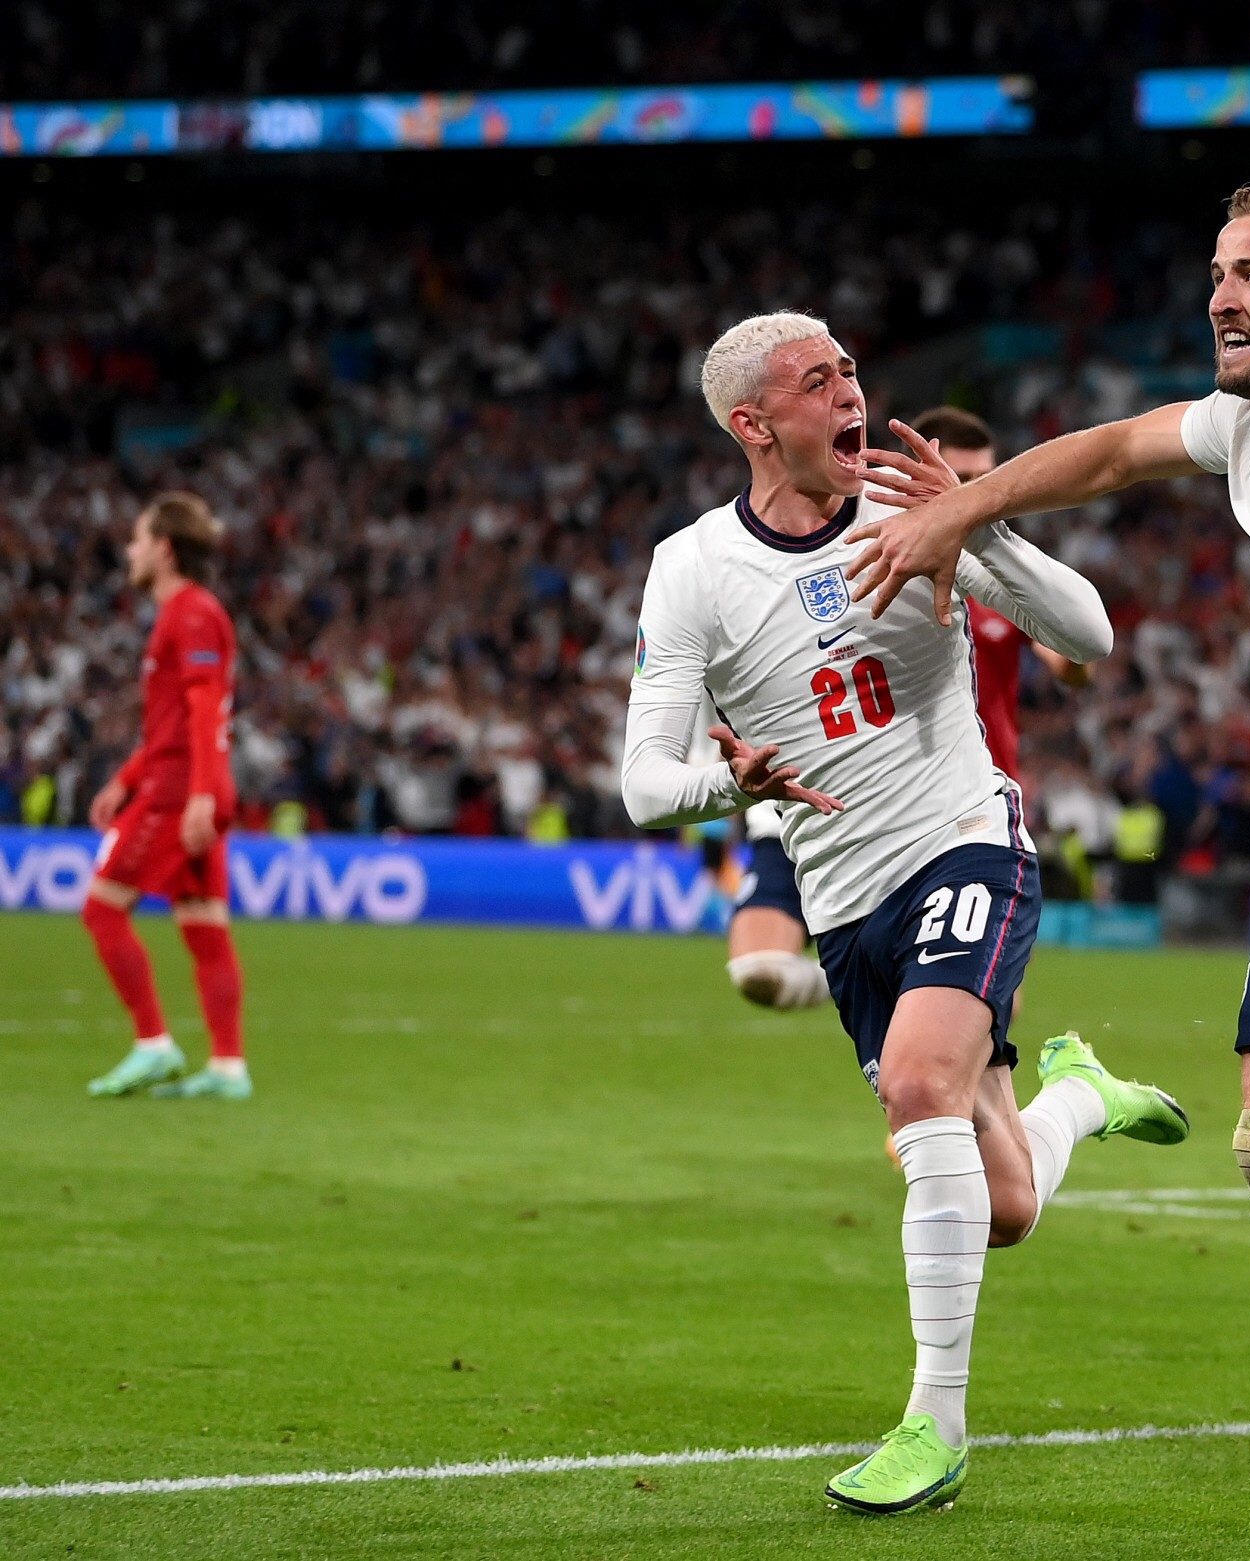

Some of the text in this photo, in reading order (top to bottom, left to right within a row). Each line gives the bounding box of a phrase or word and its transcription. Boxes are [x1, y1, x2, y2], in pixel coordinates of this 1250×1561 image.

[810, 655, 896, 741] 20
[0, 843, 94, 912] vo
[230, 838, 428, 924] vivo
[569, 842, 718, 932] viv
[914, 882, 992, 944] 20
